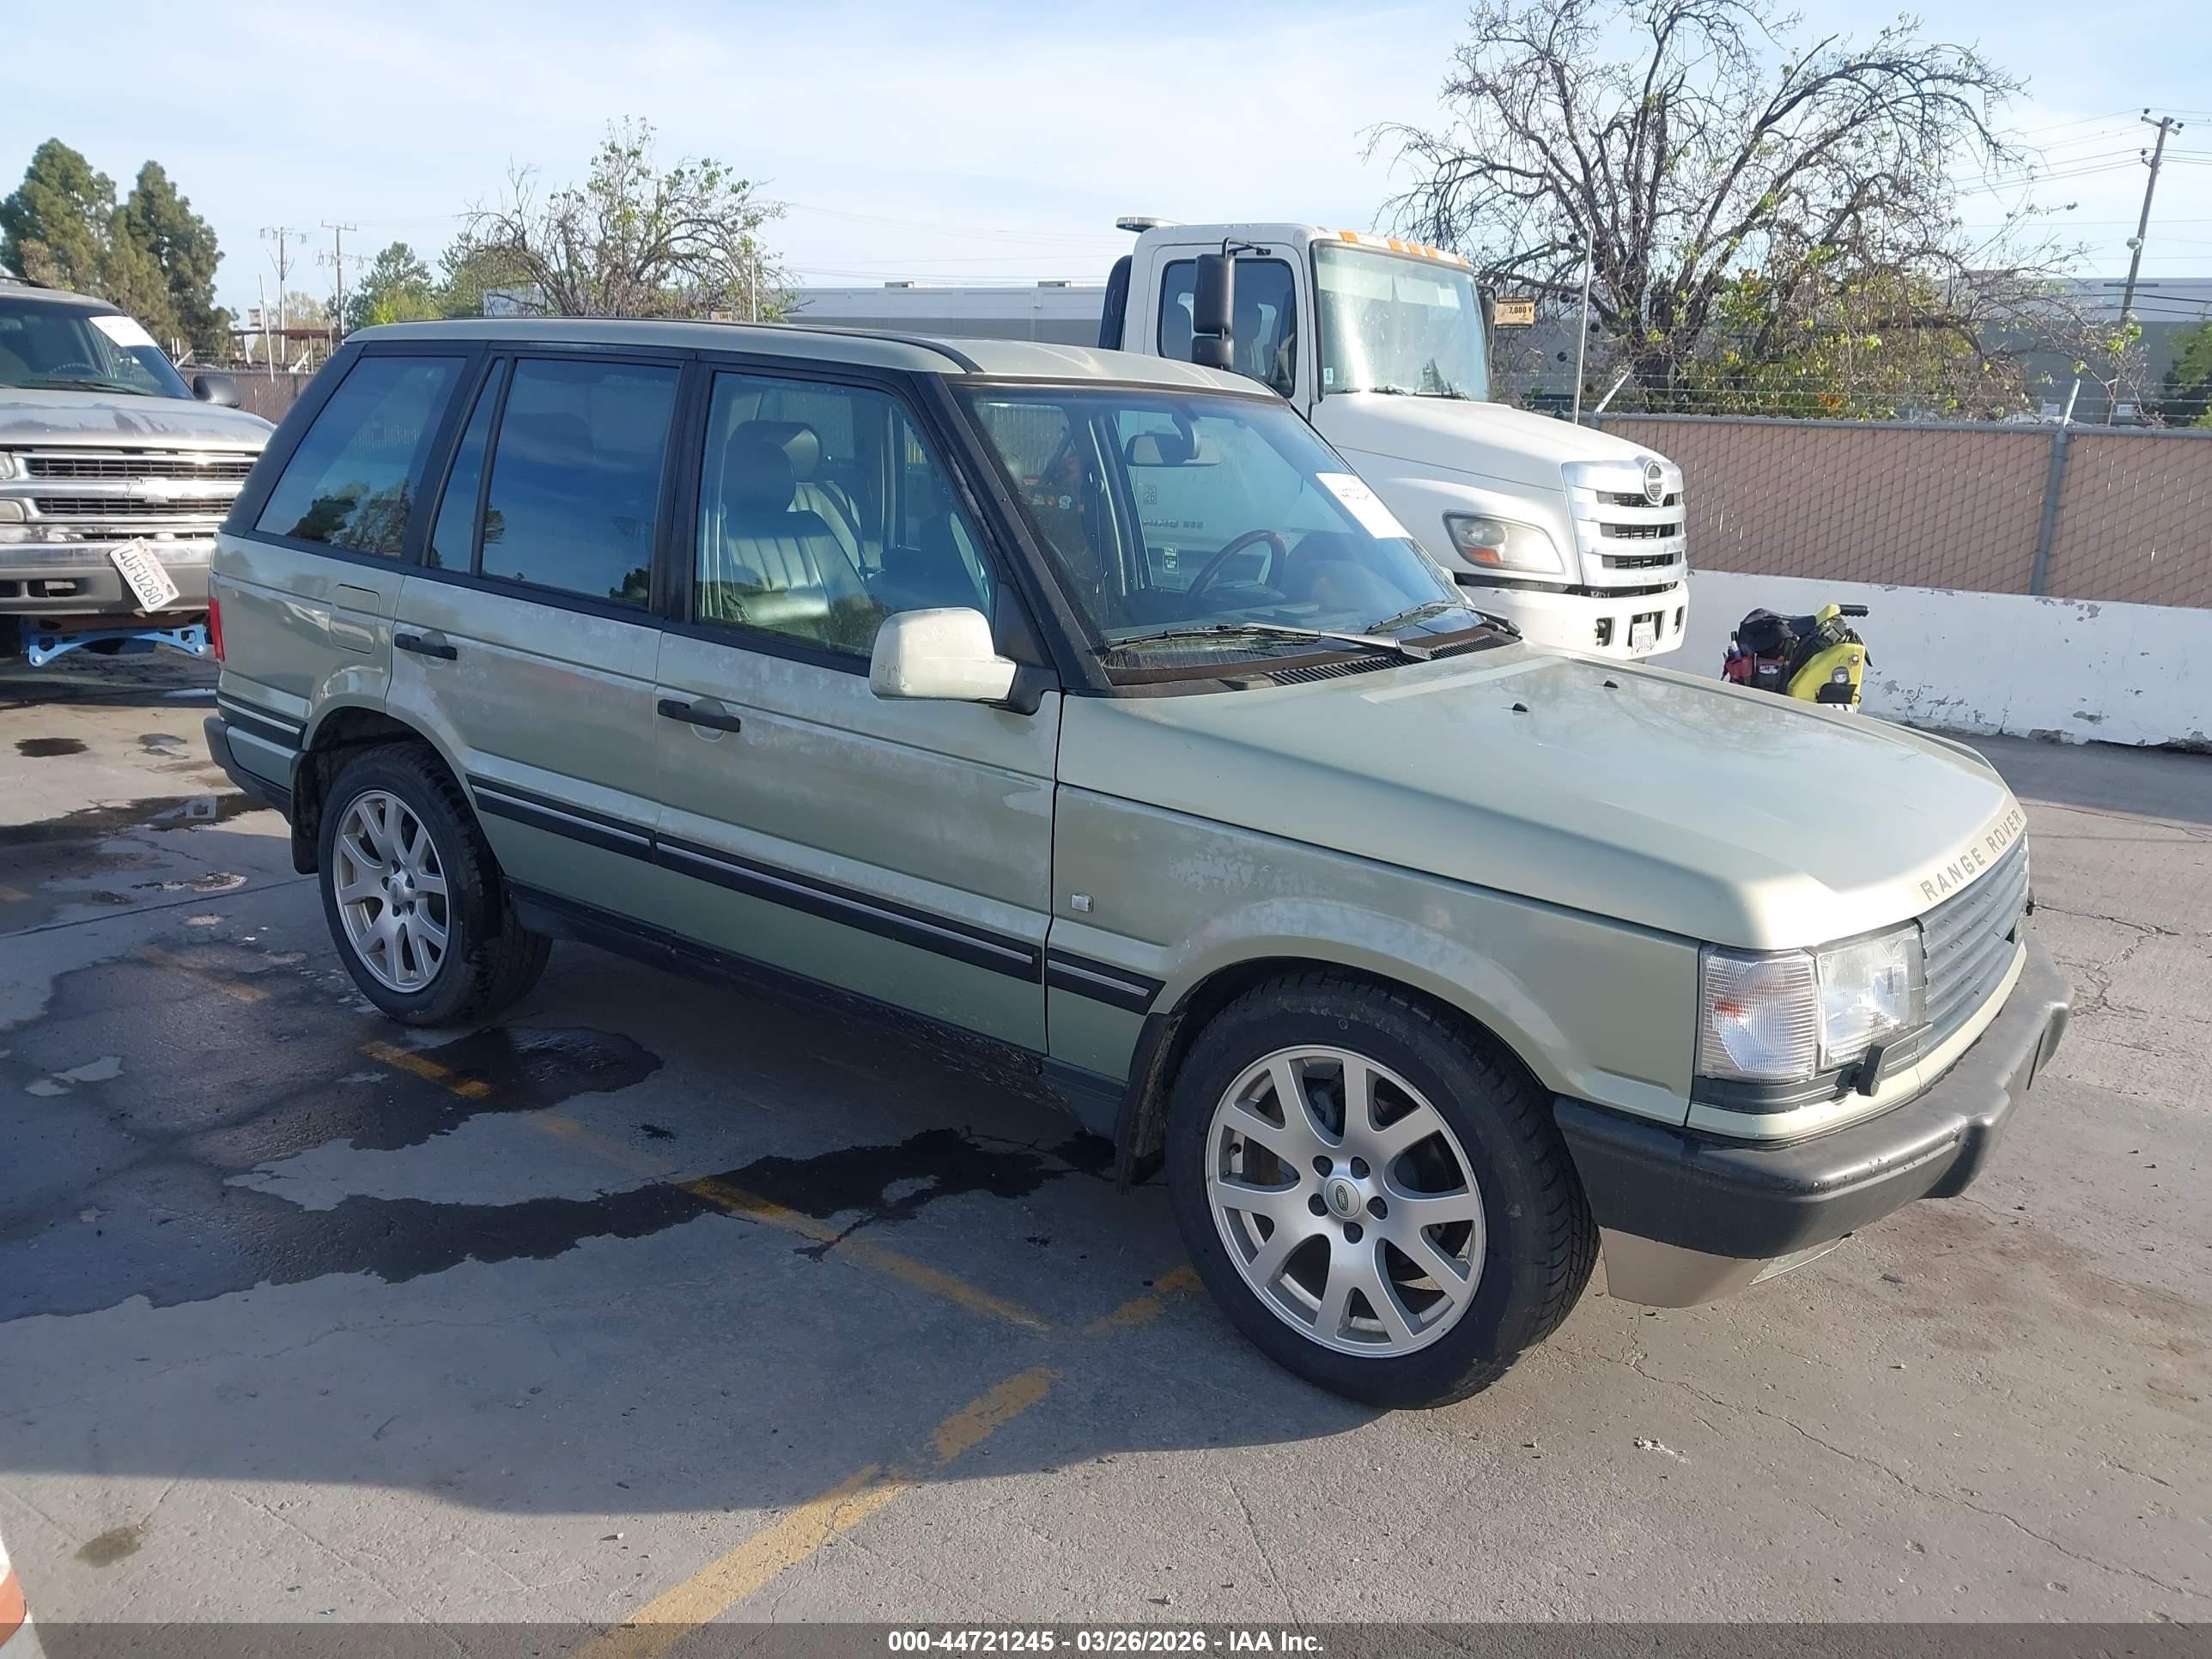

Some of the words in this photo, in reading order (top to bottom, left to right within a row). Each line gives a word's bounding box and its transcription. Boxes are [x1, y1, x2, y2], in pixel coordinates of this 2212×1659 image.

[119, 549, 164, 605] 4UFU280
[1920, 847, 1986, 901] RANGE
[1985, 809, 2023, 854] ROVER
